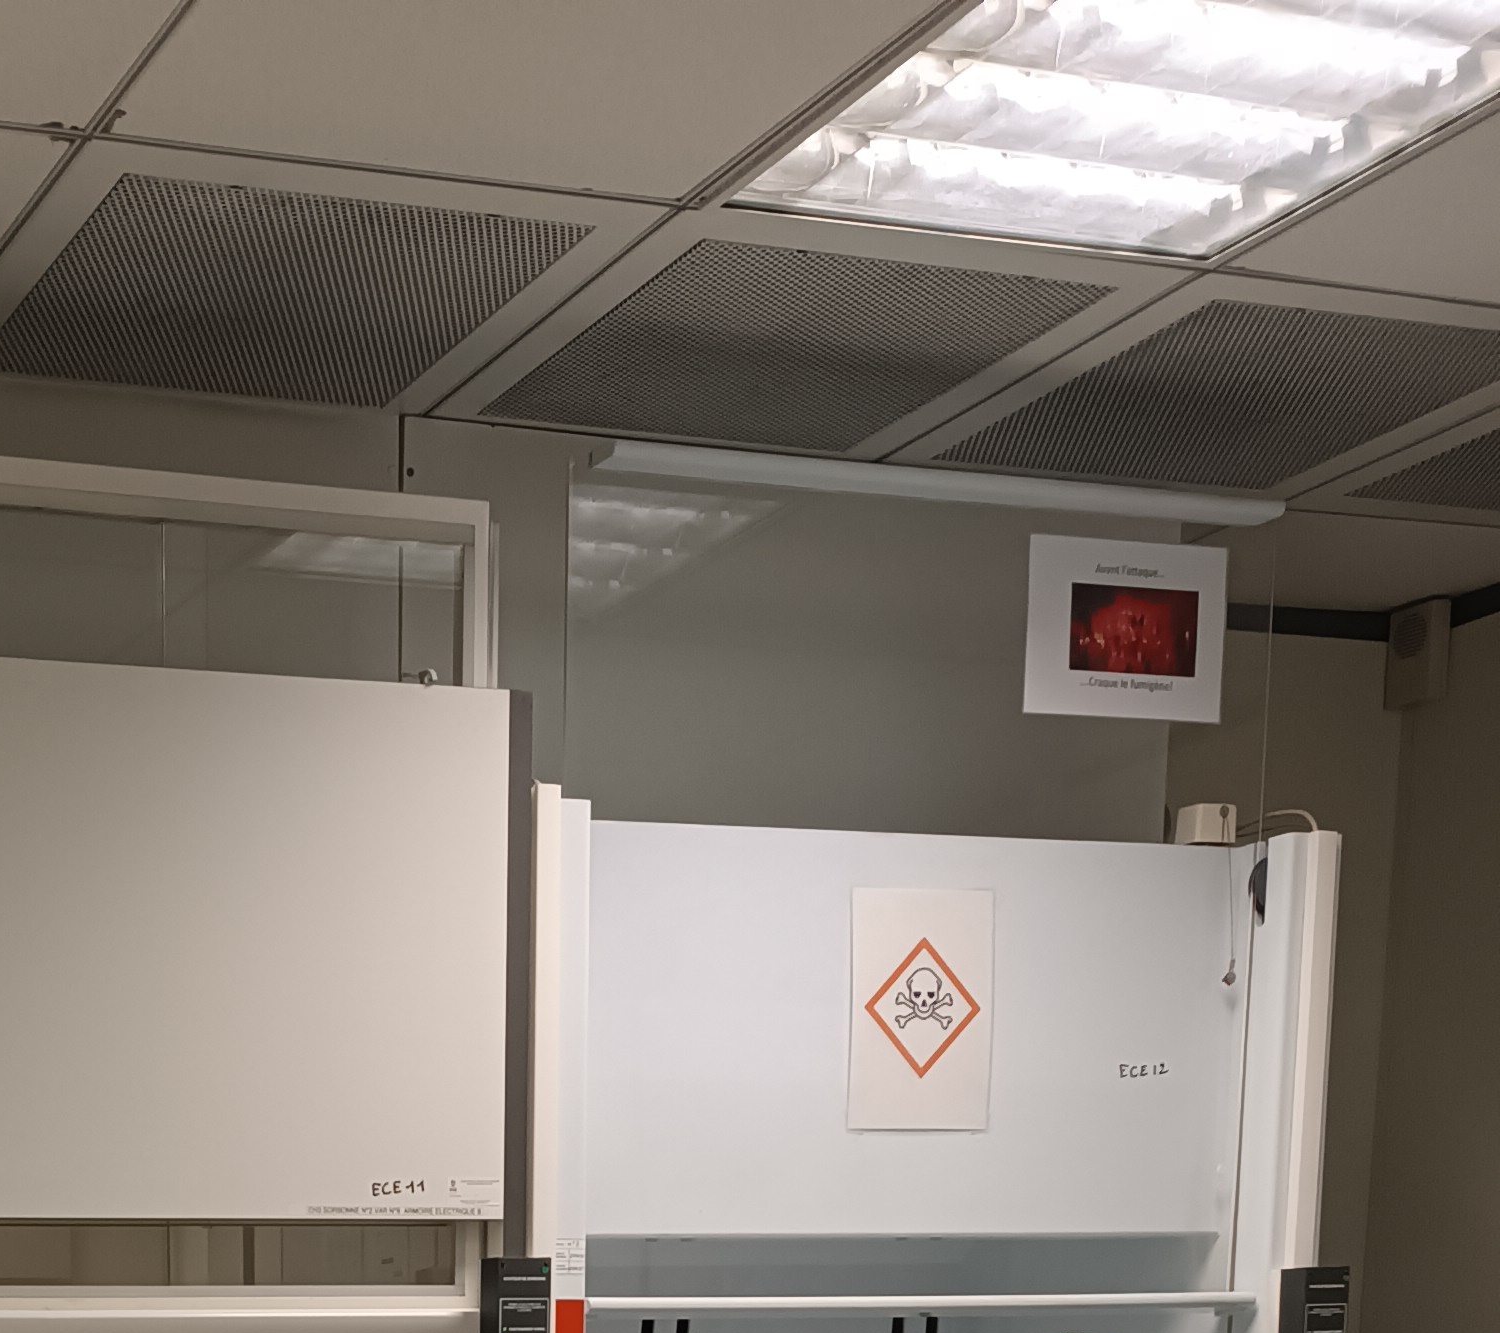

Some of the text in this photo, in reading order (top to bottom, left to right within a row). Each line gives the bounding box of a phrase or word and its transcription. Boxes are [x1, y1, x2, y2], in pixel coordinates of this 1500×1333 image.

[1119, 1062, 1170, 1079] ECE 12
[371, 1180, 425, 1197] ECE 11
